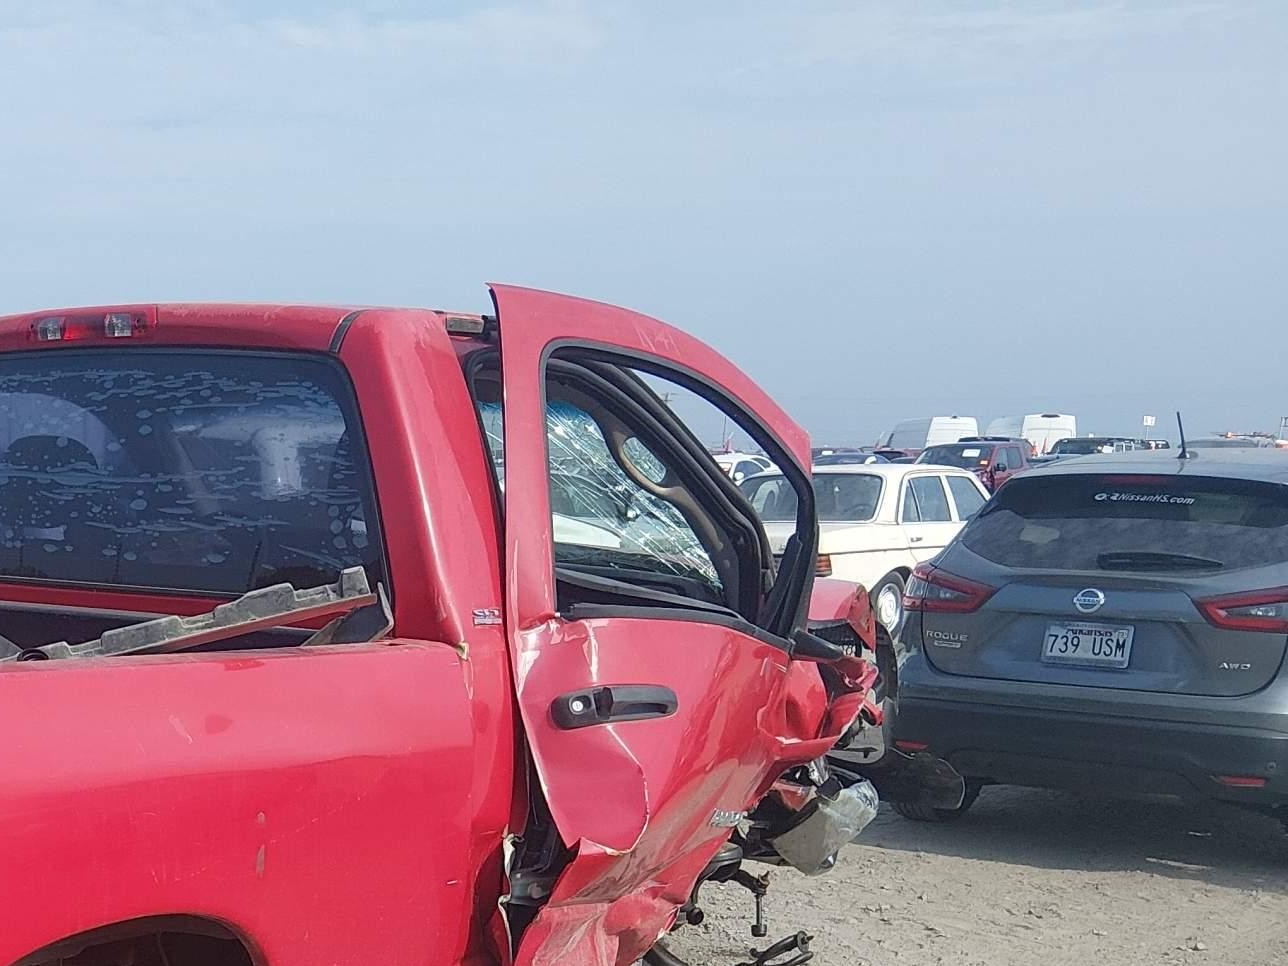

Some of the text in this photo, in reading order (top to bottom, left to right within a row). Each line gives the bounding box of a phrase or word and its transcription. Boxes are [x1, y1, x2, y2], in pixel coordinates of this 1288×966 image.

[926, 629, 969, 641] ROGUE
[1048, 633, 1127, 659] 739 USM
[1218, 661, 1251, 670] AWD
